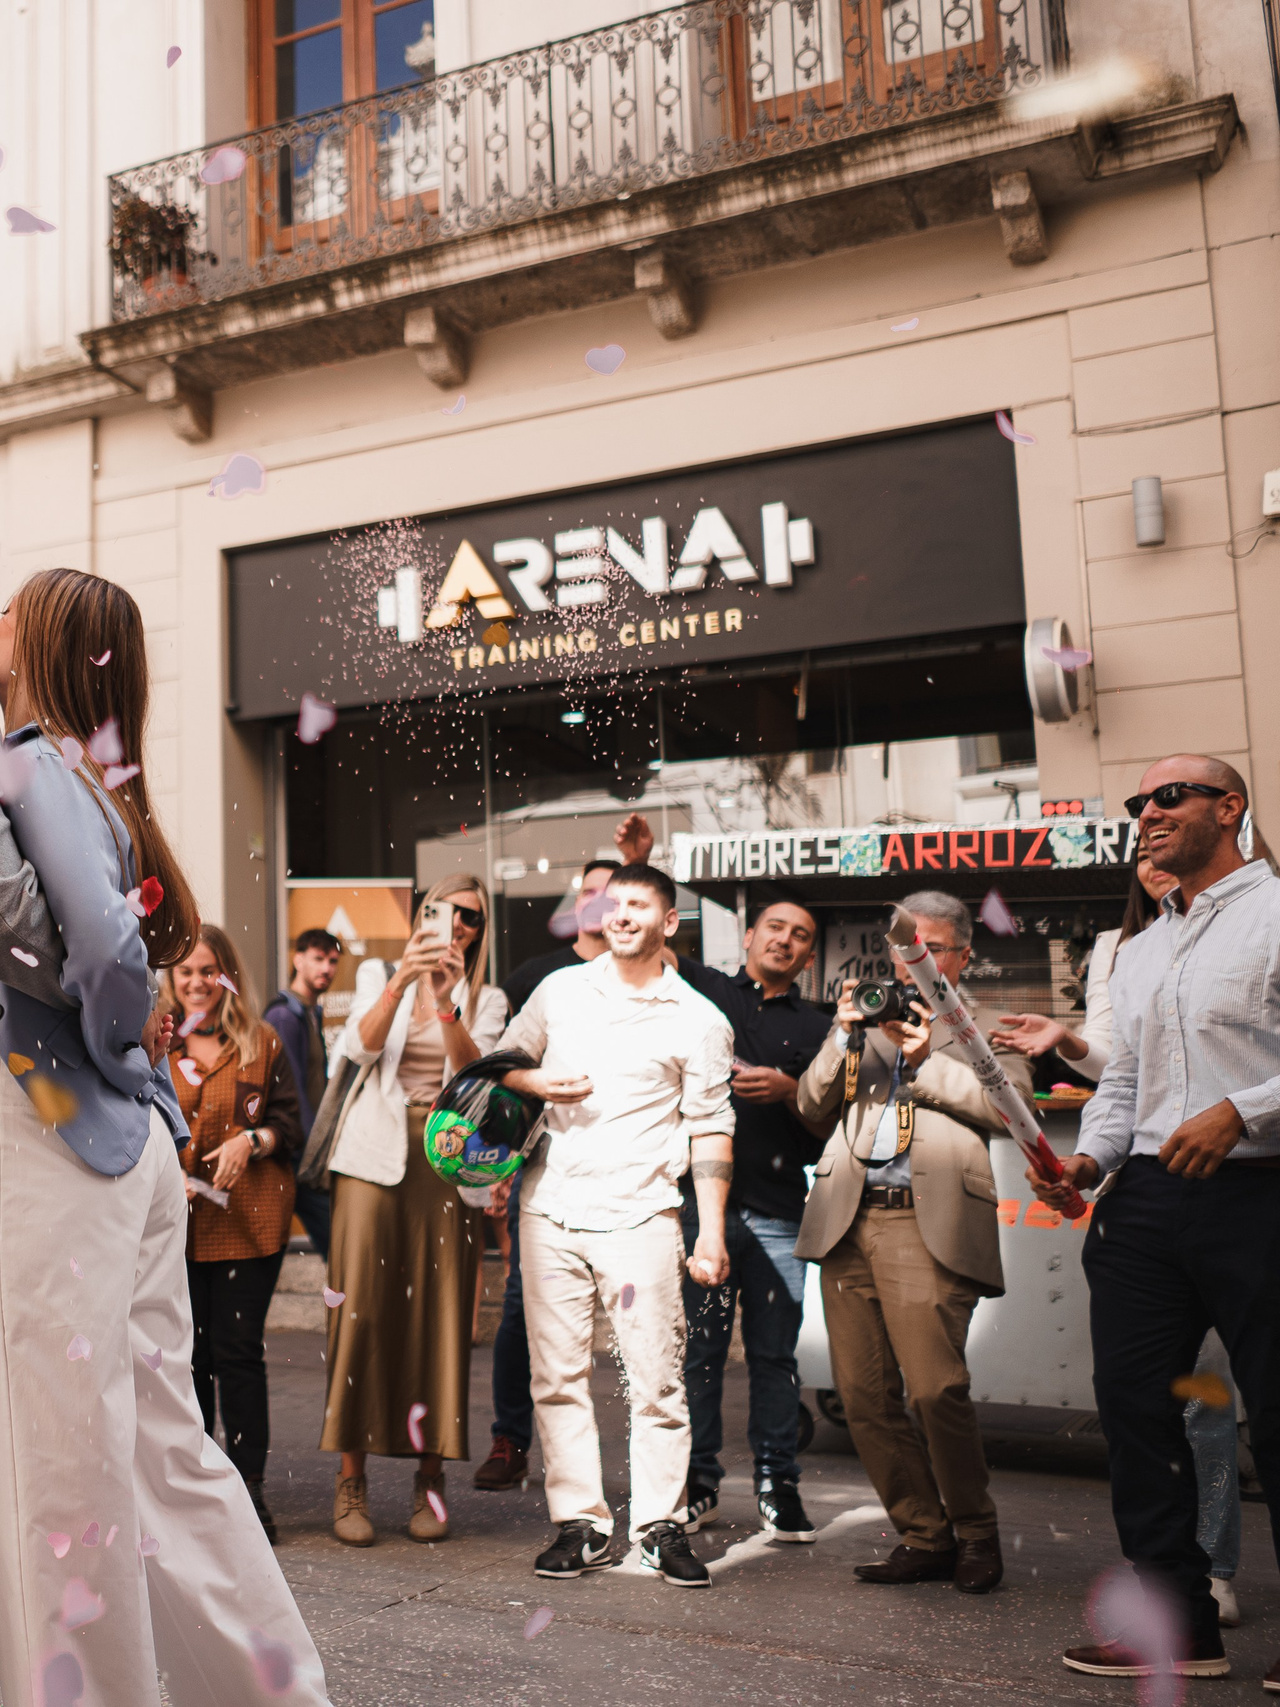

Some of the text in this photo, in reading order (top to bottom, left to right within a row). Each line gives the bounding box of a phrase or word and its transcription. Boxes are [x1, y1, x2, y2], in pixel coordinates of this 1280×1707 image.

[424, 507, 760, 630] ARENA
[450, 607, 743, 671] TRAINING CENTER
[688, 836, 840, 879] TIMBRES
[882, 827, 1052, 871] ARROZ
